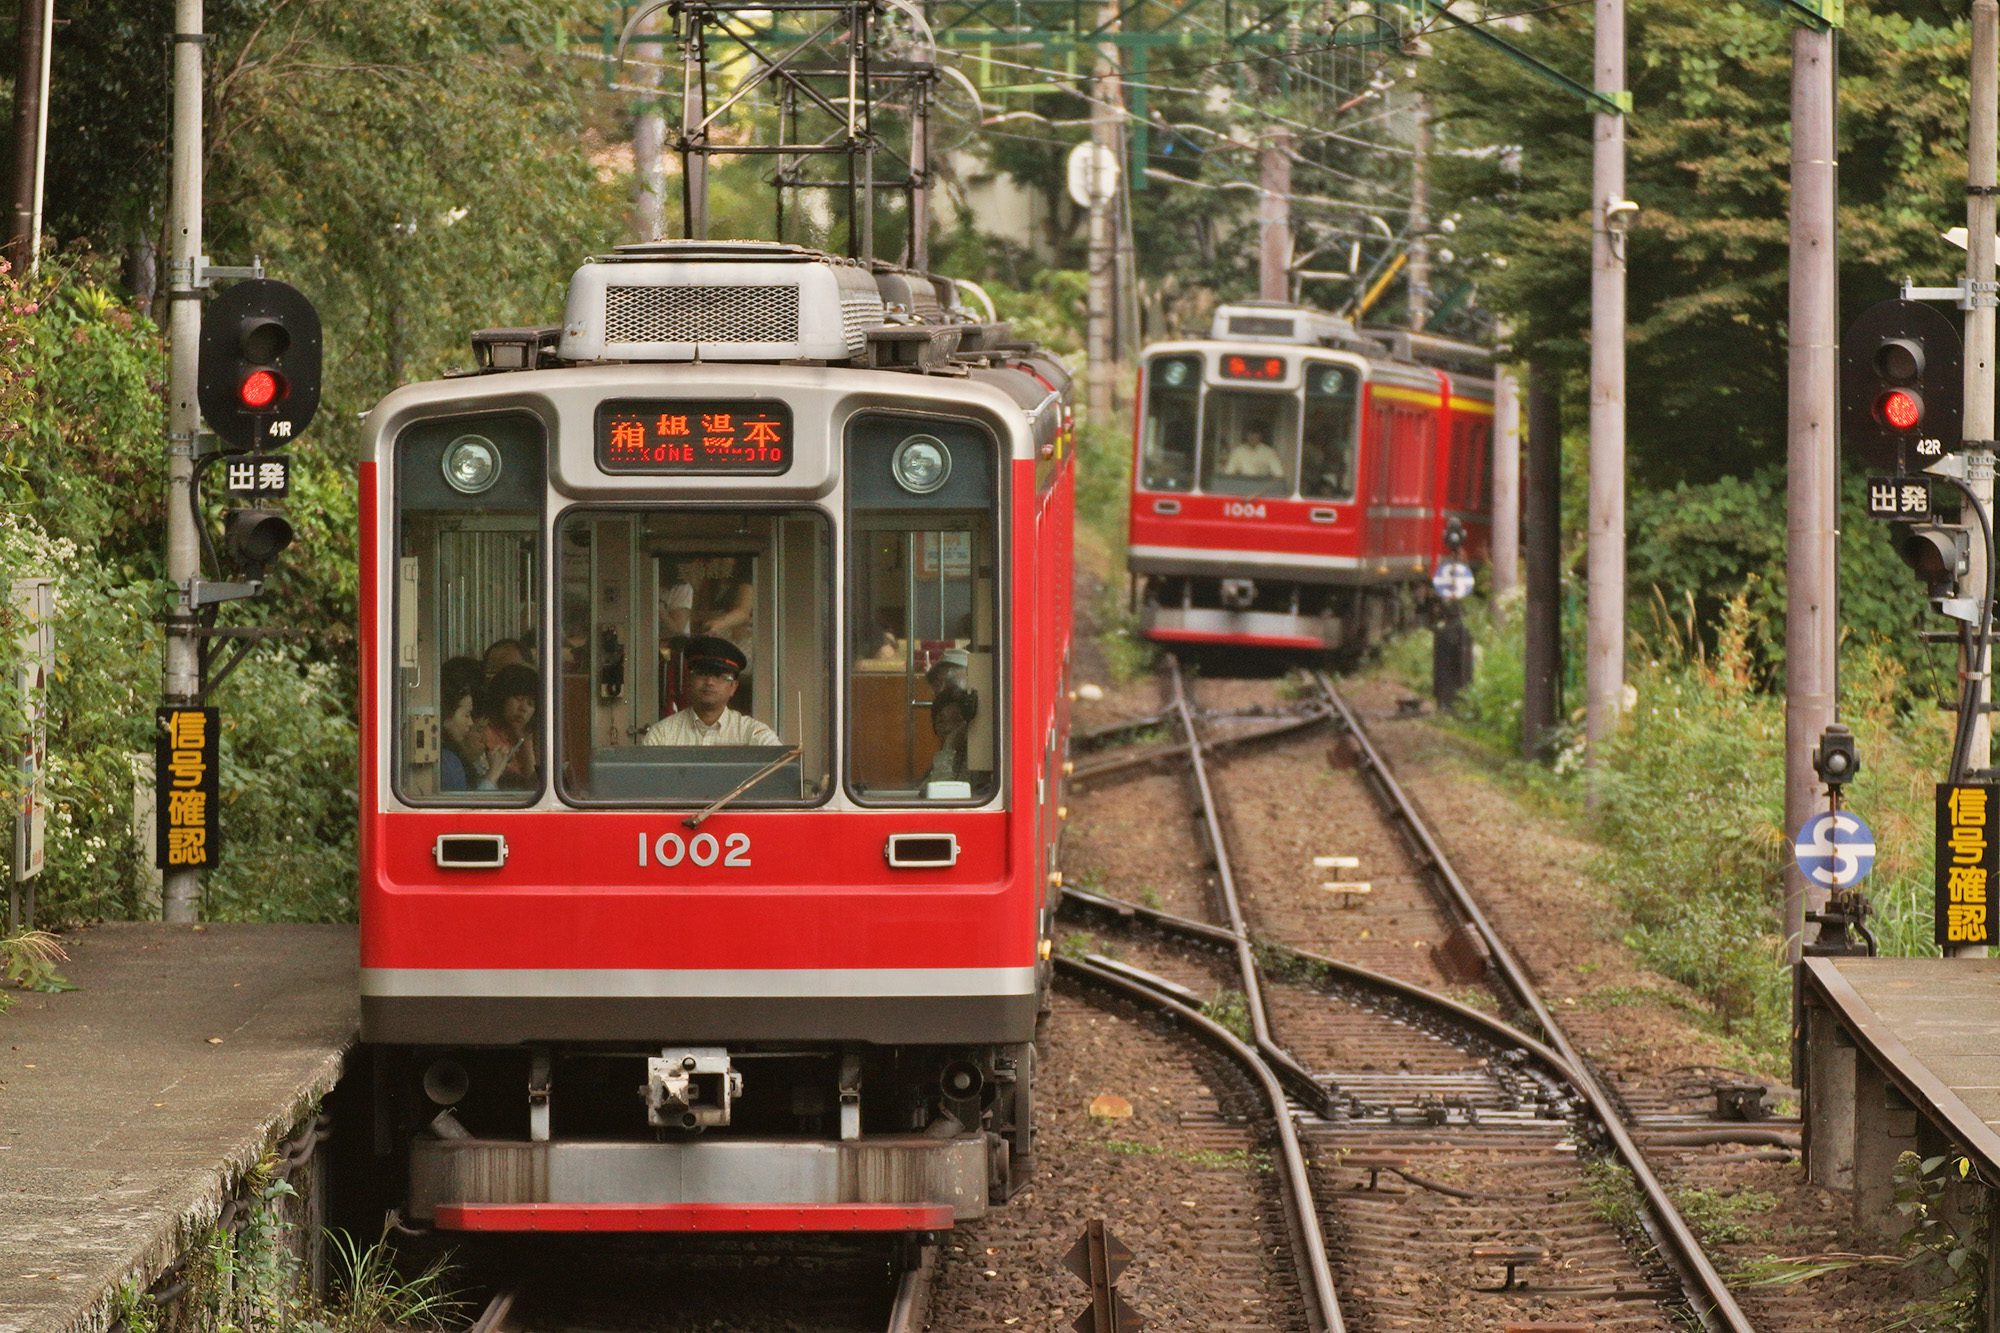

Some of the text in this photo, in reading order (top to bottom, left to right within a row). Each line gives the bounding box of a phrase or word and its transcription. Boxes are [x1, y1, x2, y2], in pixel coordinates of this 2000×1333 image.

[269, 421, 292, 437] 41R
[611, 414, 781, 448] 箱根湯本
[1916, 438, 1941, 455] 42R
[229, 463, 285, 489] 出発
[1224, 503, 1266, 518] 1004
[1871, 485, 1927, 512] 出発
[168, 711, 207, 865] 信号確認
[638, 832, 752, 867] 1002
[1947, 787, 1988, 942] 信号確認
